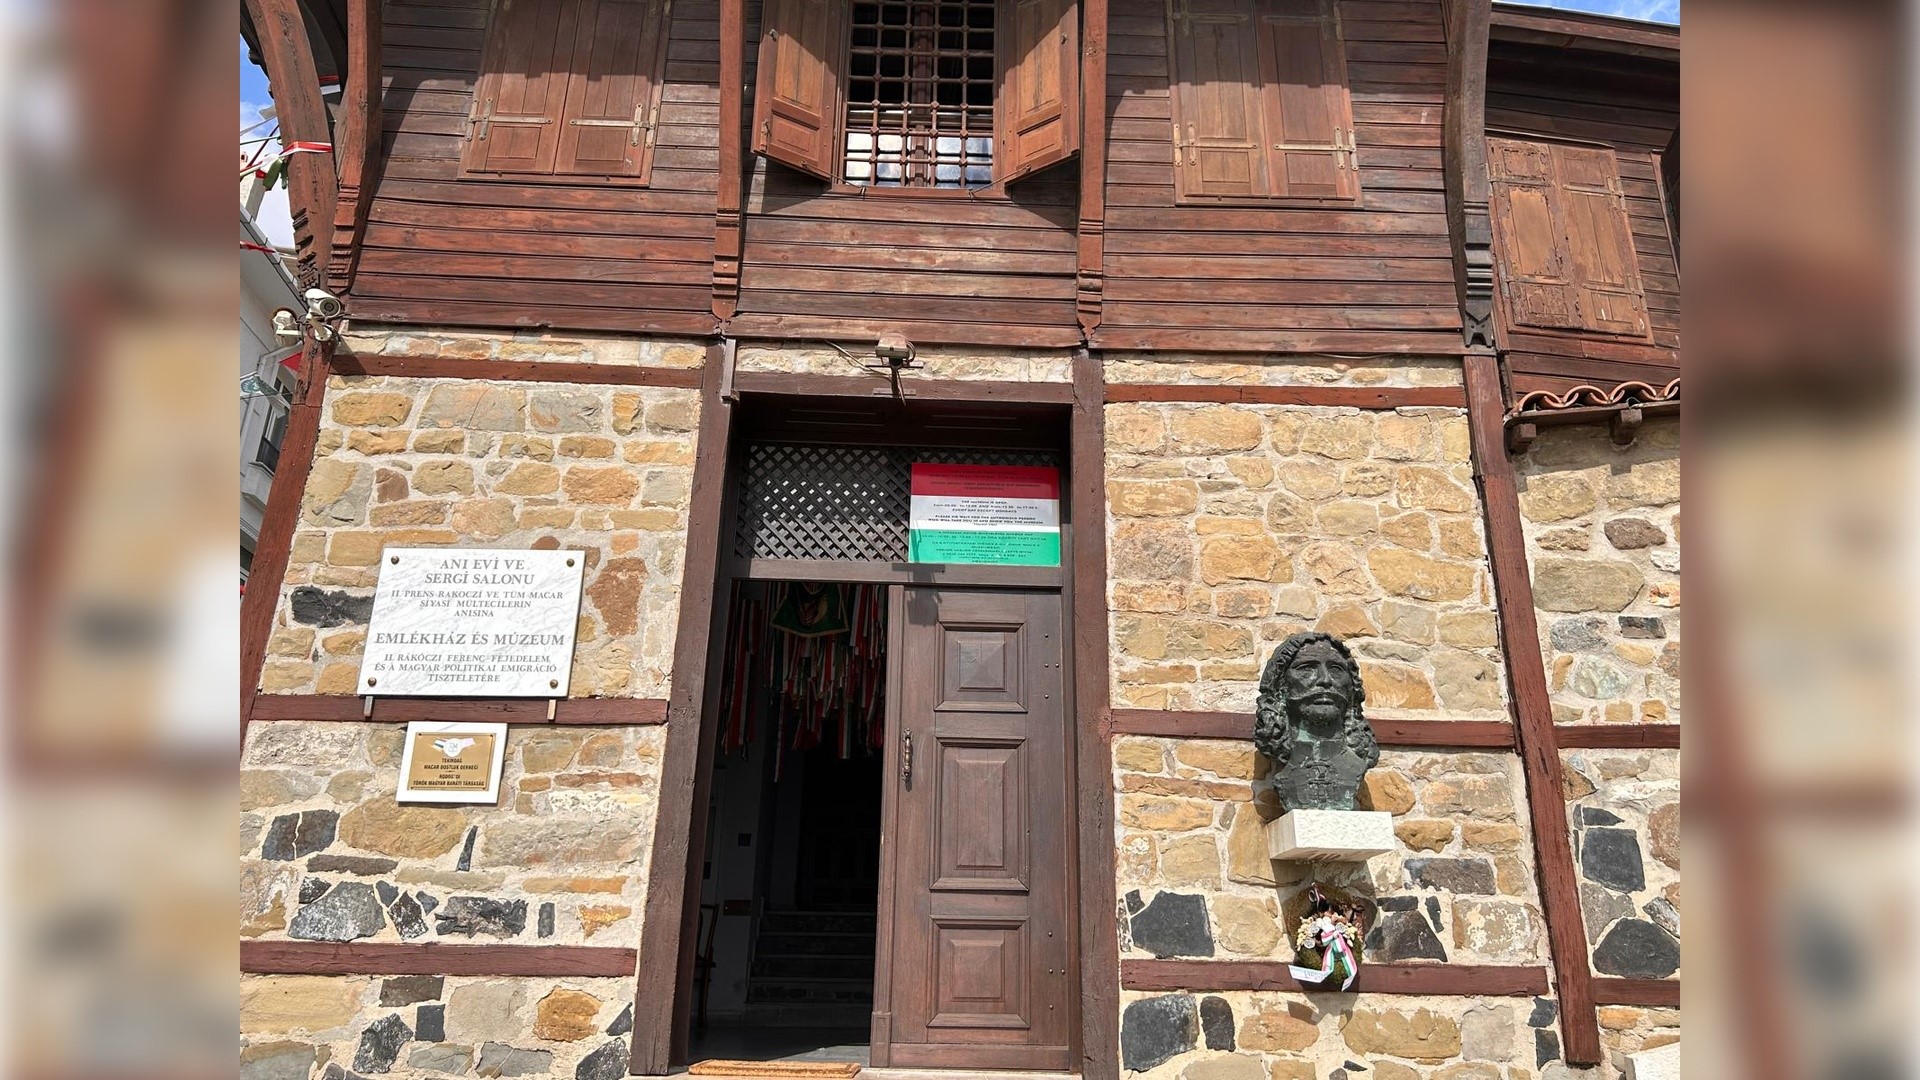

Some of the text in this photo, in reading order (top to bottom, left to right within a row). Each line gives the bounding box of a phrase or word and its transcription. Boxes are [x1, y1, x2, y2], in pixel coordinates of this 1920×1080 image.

[440, 557, 525, 570] ANI EVİ VE
[425, 571, 535, 585] SERGİ SALONU
[404, 590, 434, 598] PRENS
[529, 591, 563, 599] MACAR
[375, 631, 565, 645] EMLÉKHÁZ ÉS MÚZEUM
[397, 653, 442, 662] RÁKÓCZI
[447, 654, 485, 662] FERENC
[374, 662, 386, 671] ÉS
[500, 663, 557, 672] EMIGRÁCIÓ
[428, 673, 500, 682] TISZTELETÉRE
